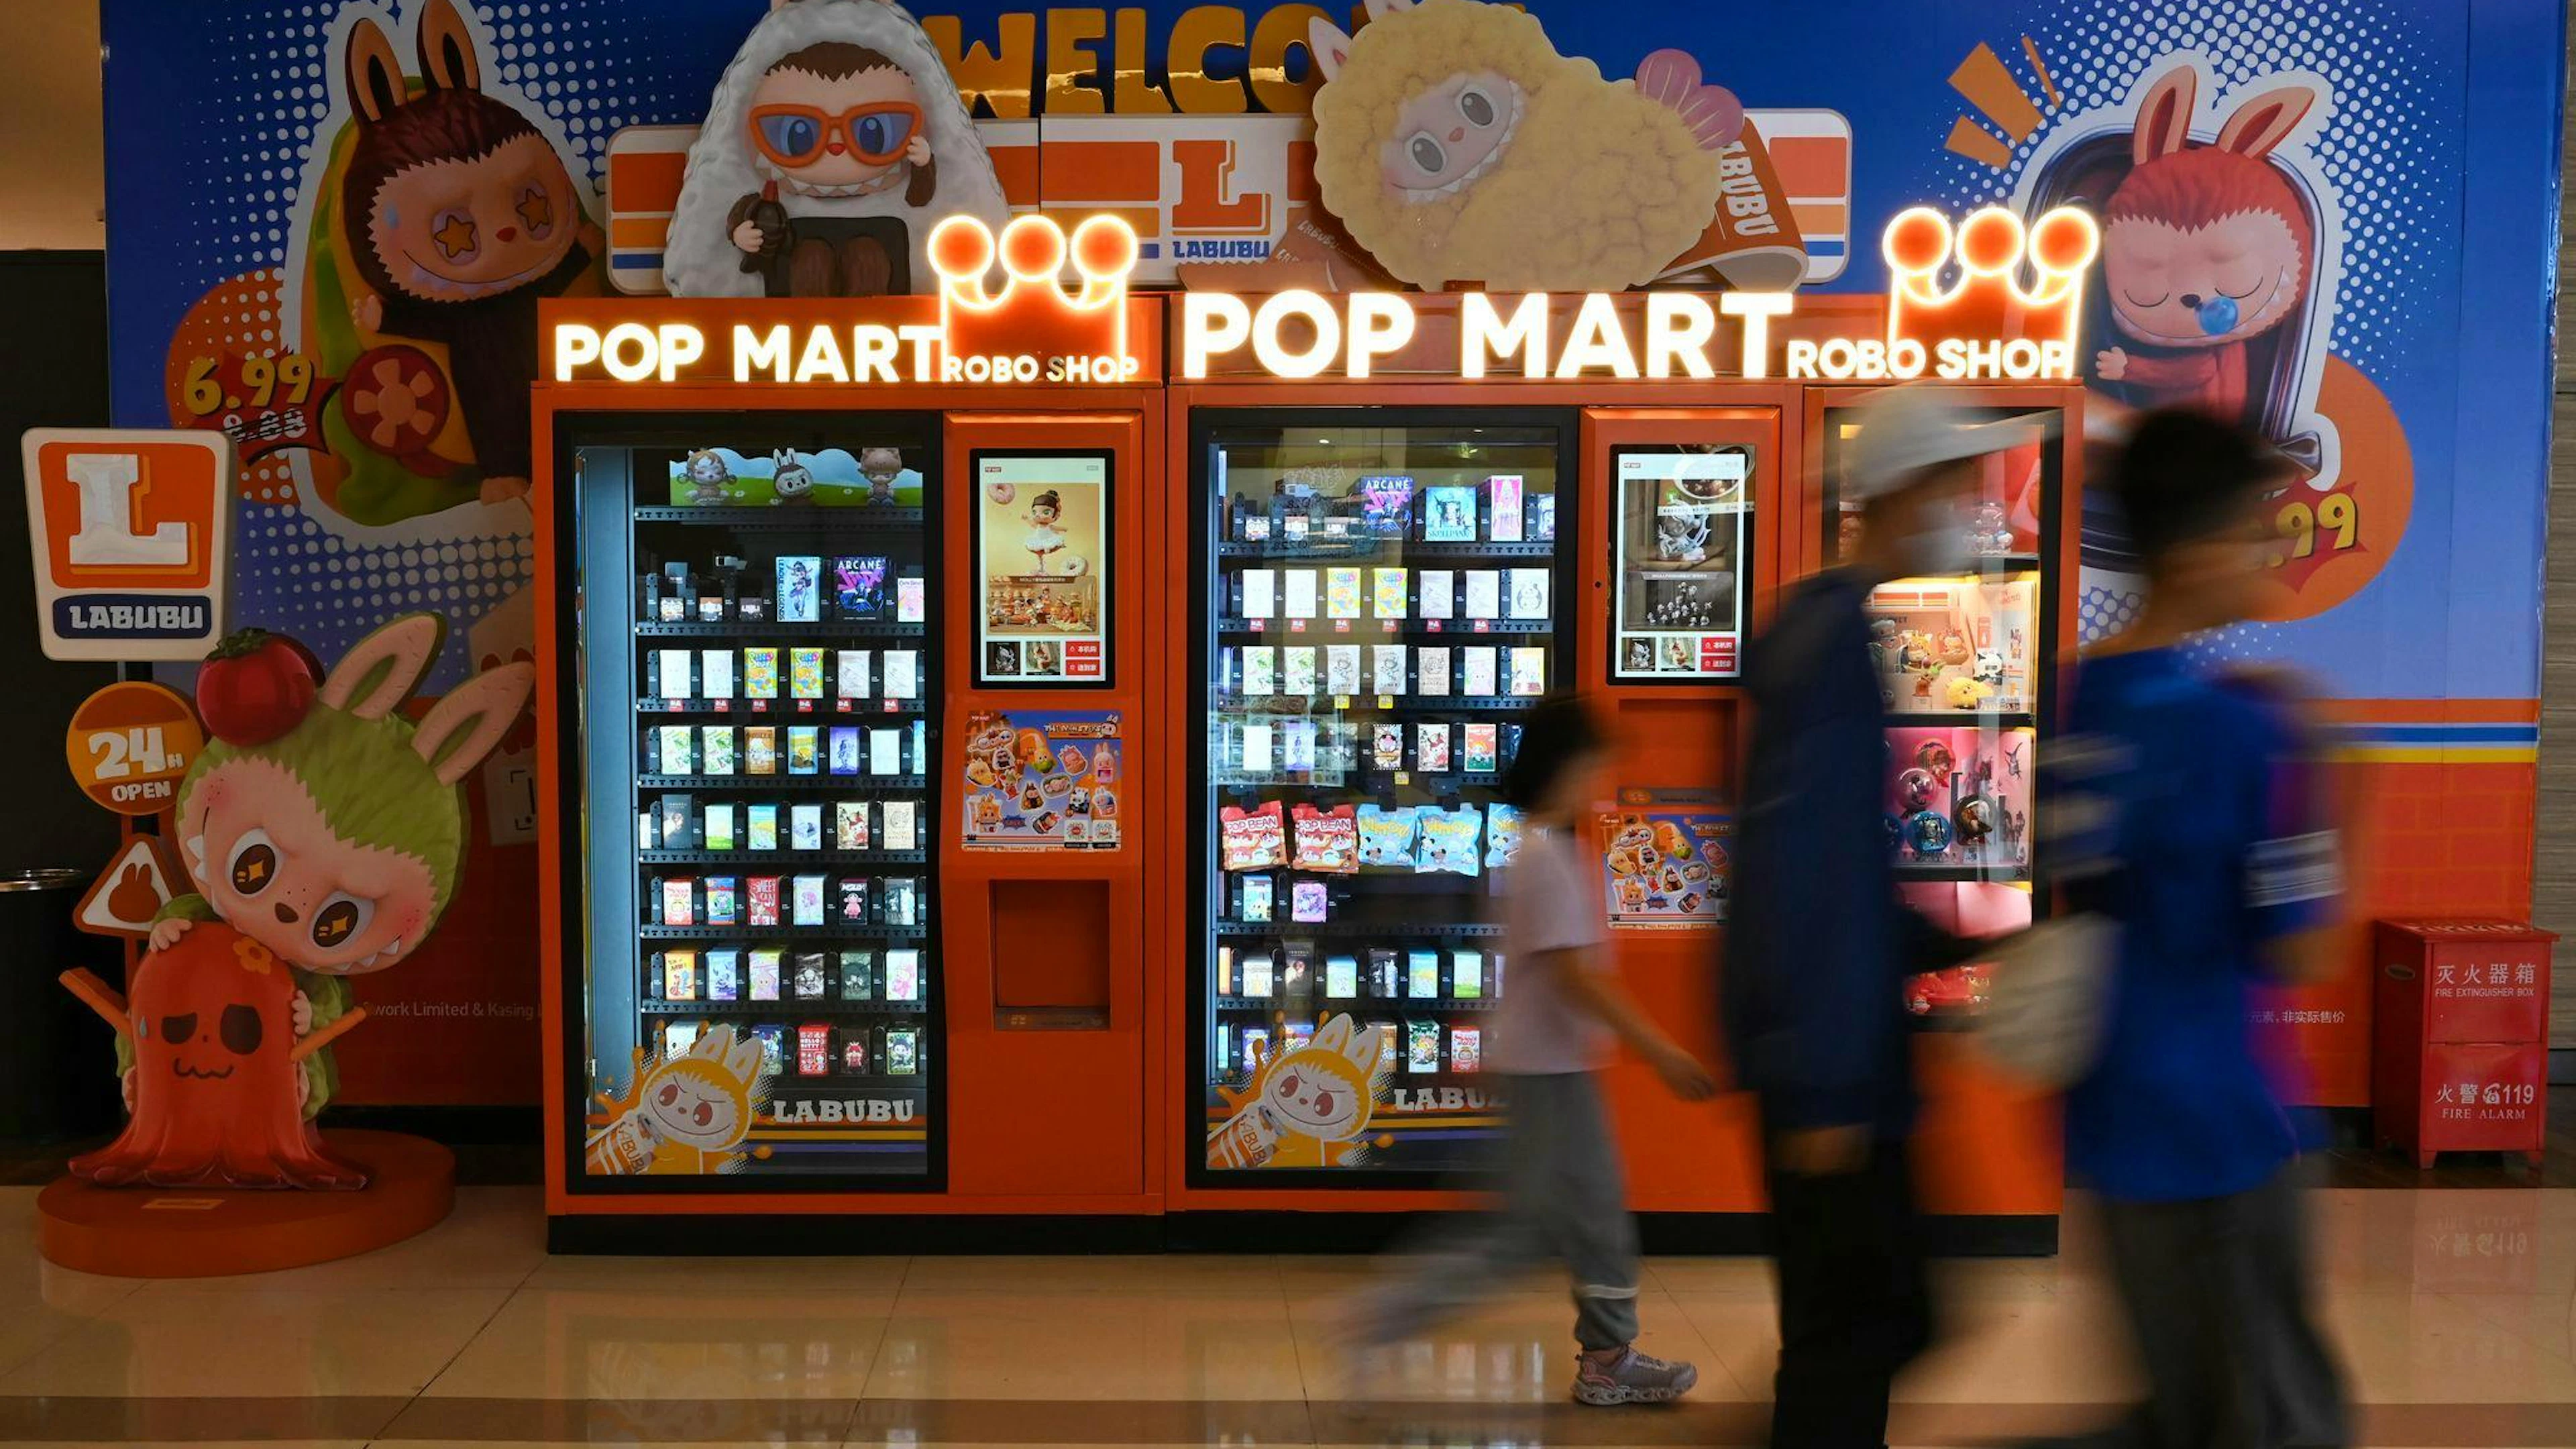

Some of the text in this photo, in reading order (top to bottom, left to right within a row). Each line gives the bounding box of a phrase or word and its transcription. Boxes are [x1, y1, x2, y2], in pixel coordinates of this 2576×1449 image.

[920, 3, 1375, 119] WELCO
[1721, 140, 1780, 235] ABUBU
[1173, 241, 1270, 258] LABUBU
[1184, 289, 2074, 379] POP MART ROBO SHOP
[555, 322, 1139, 382] POP MART ROBO SHOP
[184, 354, 312, 416] 6.99
[69, 605, 203, 629] LABUBU
[111, 780, 172, 802] OPEN
[2435, 963, 2536, 985] 灭火器箱
[2435, 988, 2453, 998] FIRE
[2456, 988, 2514, 998] EXTINGUISHER
[413, 1002, 469, 1016] Limited
[2435, 1083, 2534, 1104] 火警 119
[772, 1099, 914, 1123] LABUBU
[2442, 1108, 2526, 1120] FIRE ALARM
